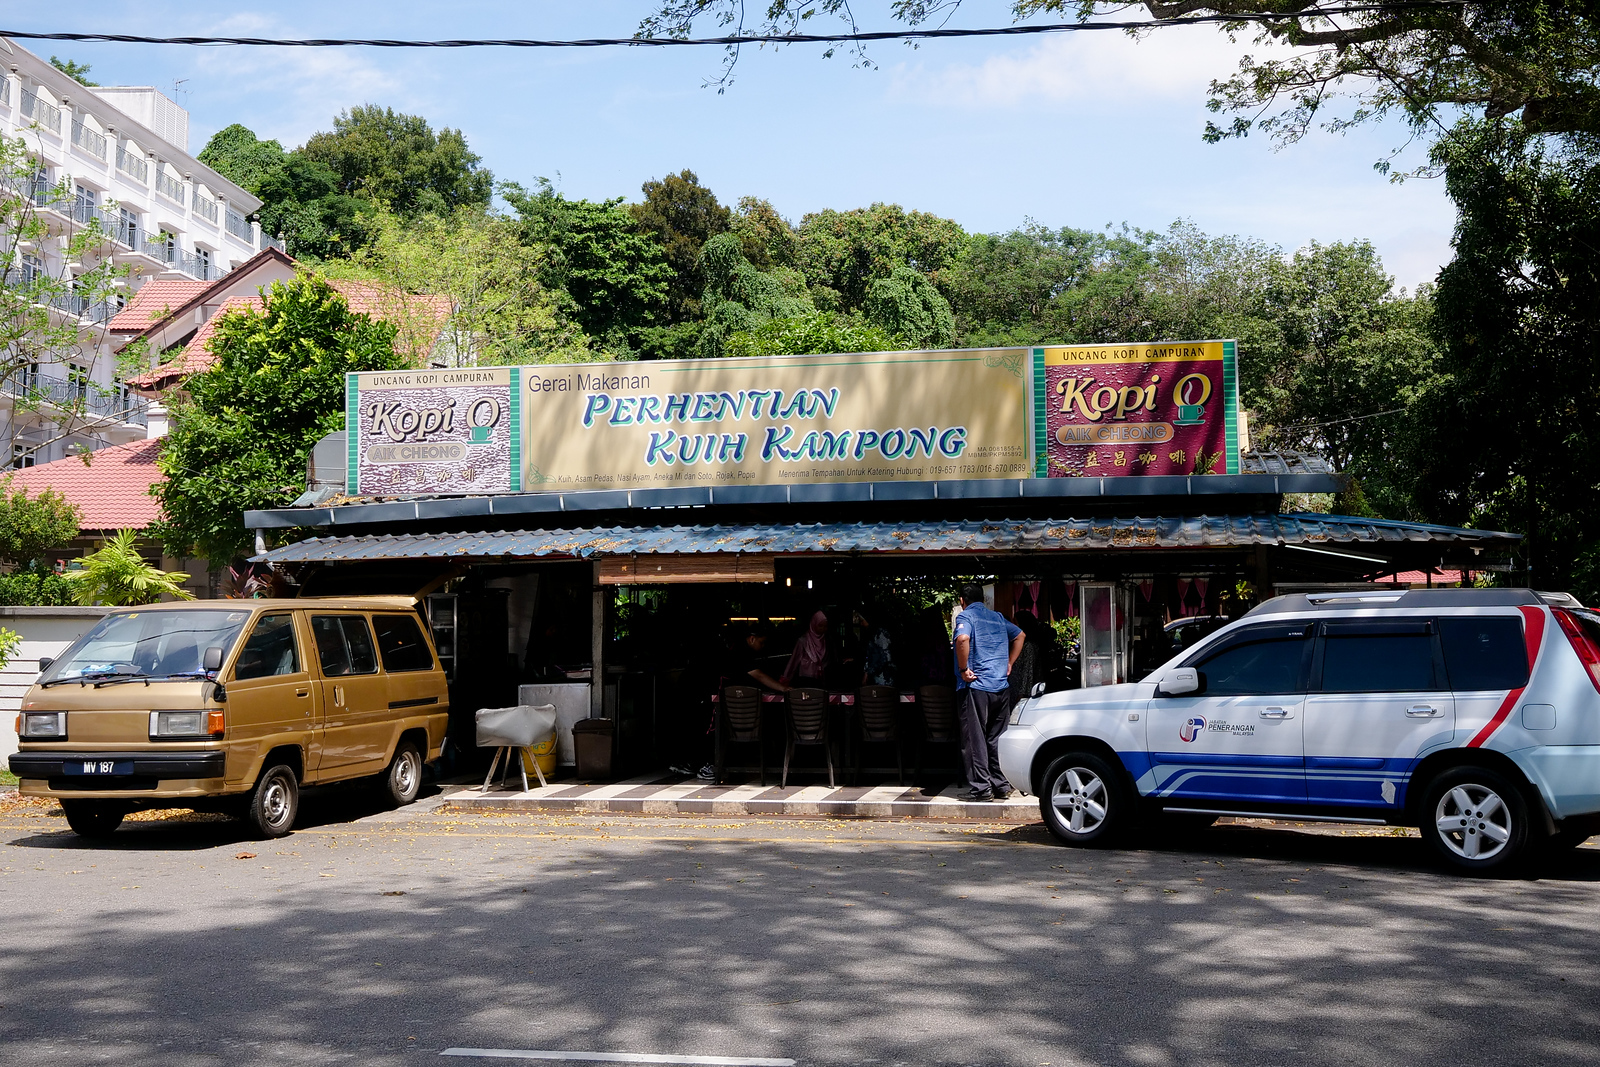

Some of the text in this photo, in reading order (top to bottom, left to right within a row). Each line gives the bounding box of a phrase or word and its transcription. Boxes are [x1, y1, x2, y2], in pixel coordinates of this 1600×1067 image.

[1063, 347, 1206, 361] UNCANG KOPI CAMPURAN
[373, 373, 495, 386] UNCANG KOPI CAMPURAN
[528, 373, 650, 392] Gerai Makanan
[1056, 374, 1162, 421] Kopi
[582, 387, 840, 428] PERHENTIAN
[366, 398, 456, 442] Kopi
[1065, 426, 1167, 441] AIK CHEONG
[373, 445, 461, 460] AIK CHEONG
[645, 424, 968, 467] KUIH KAMPONG
[558, 475, 573, 484] Kuih,
[575, 474, 592, 483] Asam
[594, 474, 614, 482] Pedas,
[617, 473, 631, 482] Nasi
[632, 473, 652, 483] Ayam,
[654, 472, 673, 481] Aneka
[675, 472, 683, 480] Mi
[684, 472, 696, 480] dan
[698, 471, 713, 480] Soto,
[716, 471, 735, 481] Rojak,
[778, 469, 809, 478] Menerima
[812, 468, 844, 478] Tempahan
[846, 467, 865, 476] Untuk
[867, 467, 895, 477] Katering
[930, 465, 957, 474] 019-657
[1009, 463, 1026, 472] 0889
[1208, 724, 1255, 732] PENERANGAN
[84, 761, 114, 773] MV 187
